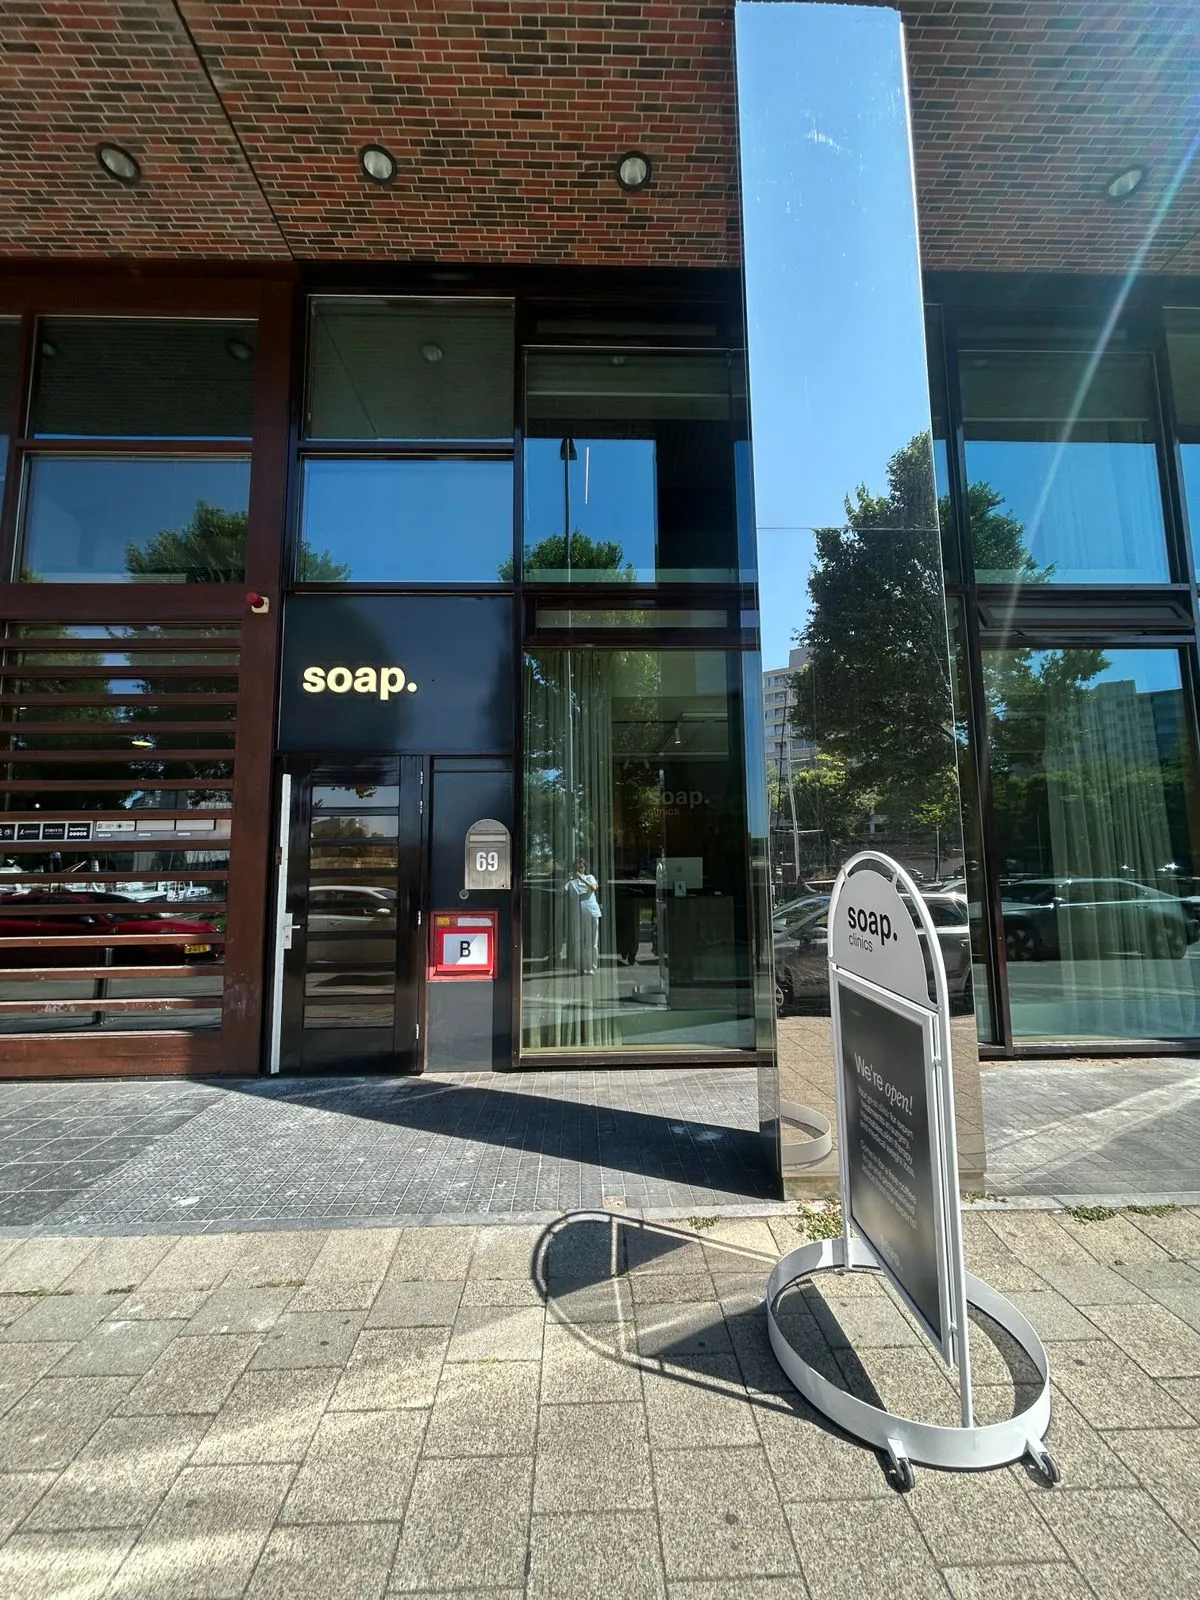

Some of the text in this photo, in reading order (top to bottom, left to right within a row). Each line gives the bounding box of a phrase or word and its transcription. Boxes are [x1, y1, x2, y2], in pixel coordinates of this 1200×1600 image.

[302, 666, 418, 700] soap.
[476, 851, 499, 871] 69
[848, 906, 898, 946] soap.
[460, 941, 471, 957] B
[849, 933, 873, 952] clinics
[854, 1052, 883, 1091] We're
[885, 1082, 913, 1116] open!
